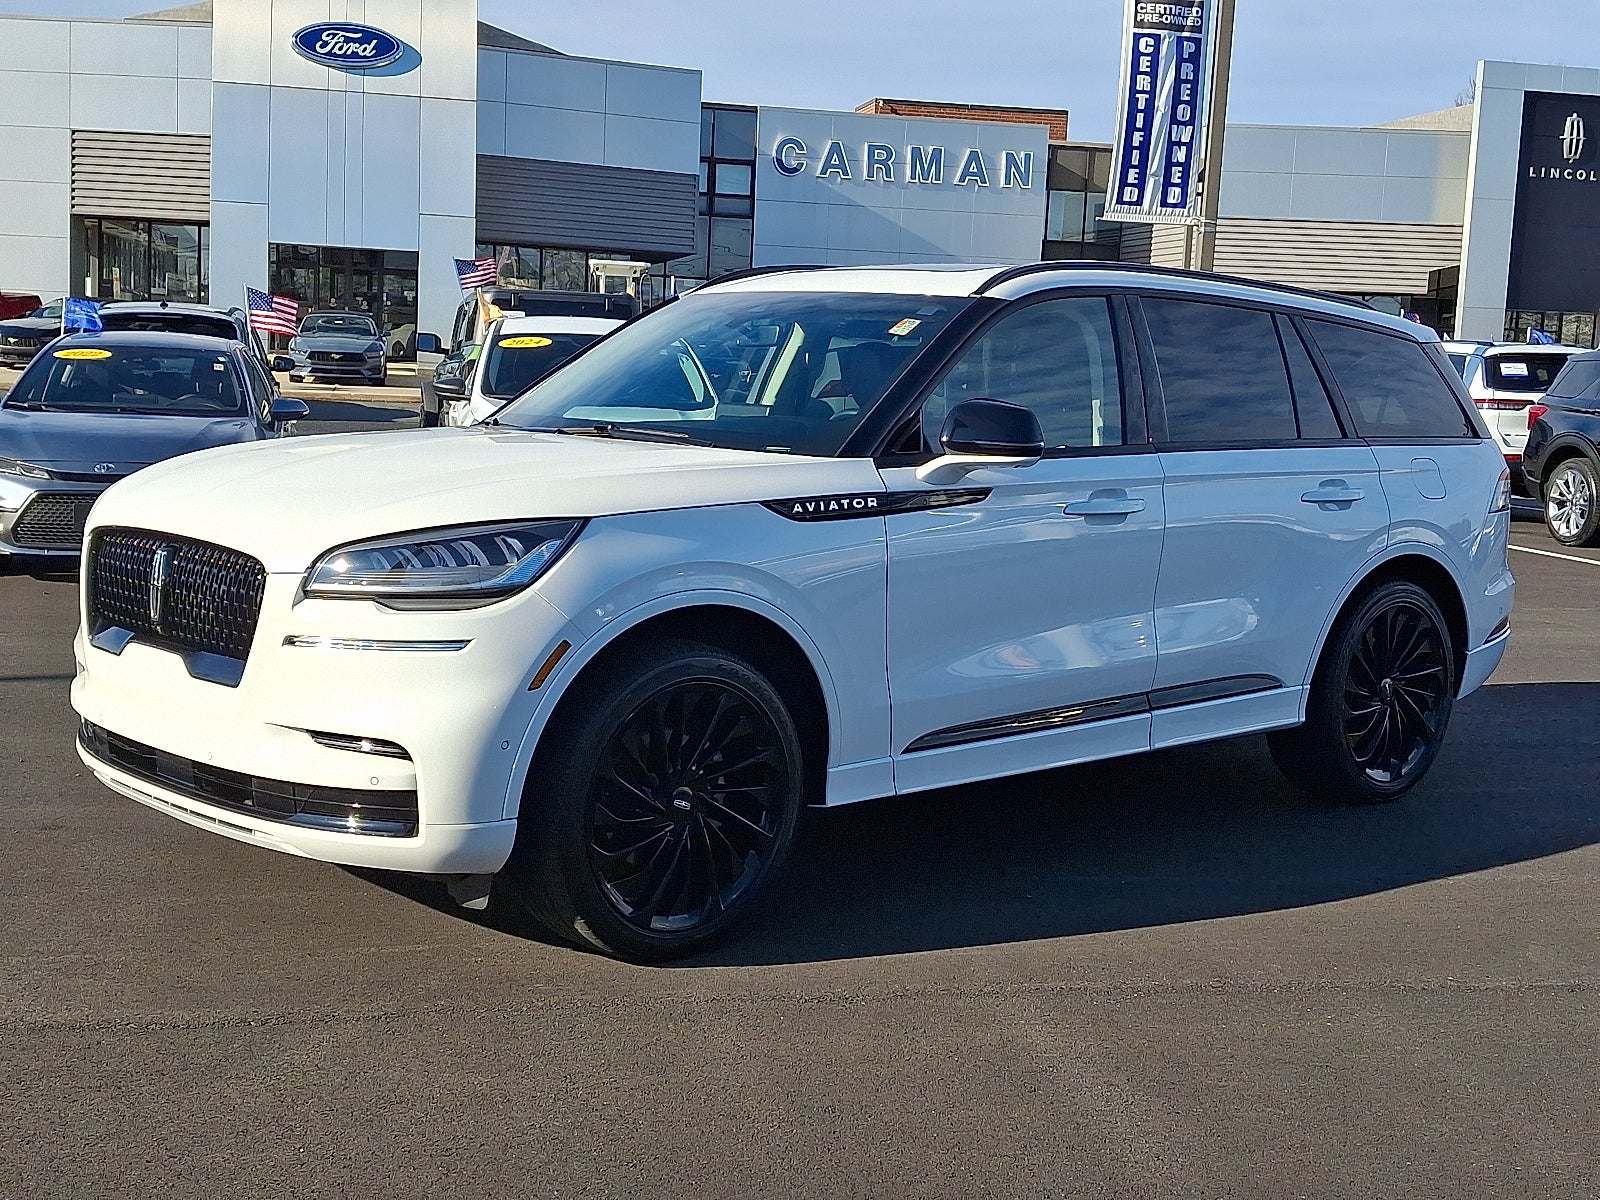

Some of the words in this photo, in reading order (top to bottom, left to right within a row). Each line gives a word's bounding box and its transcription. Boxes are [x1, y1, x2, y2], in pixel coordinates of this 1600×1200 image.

[1136, 3, 1202, 17] CERTIFIED
[1136, 14, 1202, 26] PRE-OWNED
[315, 30, 378, 57] Ford
[1122, 36, 1155, 203] CERTIFIED
[1166, 41, 1196, 204] PREOWNED
[772, 135, 1034, 189] CARMAN
[506, 338, 544, 346] 2024
[792, 497, 878, 513] AVIATOR
